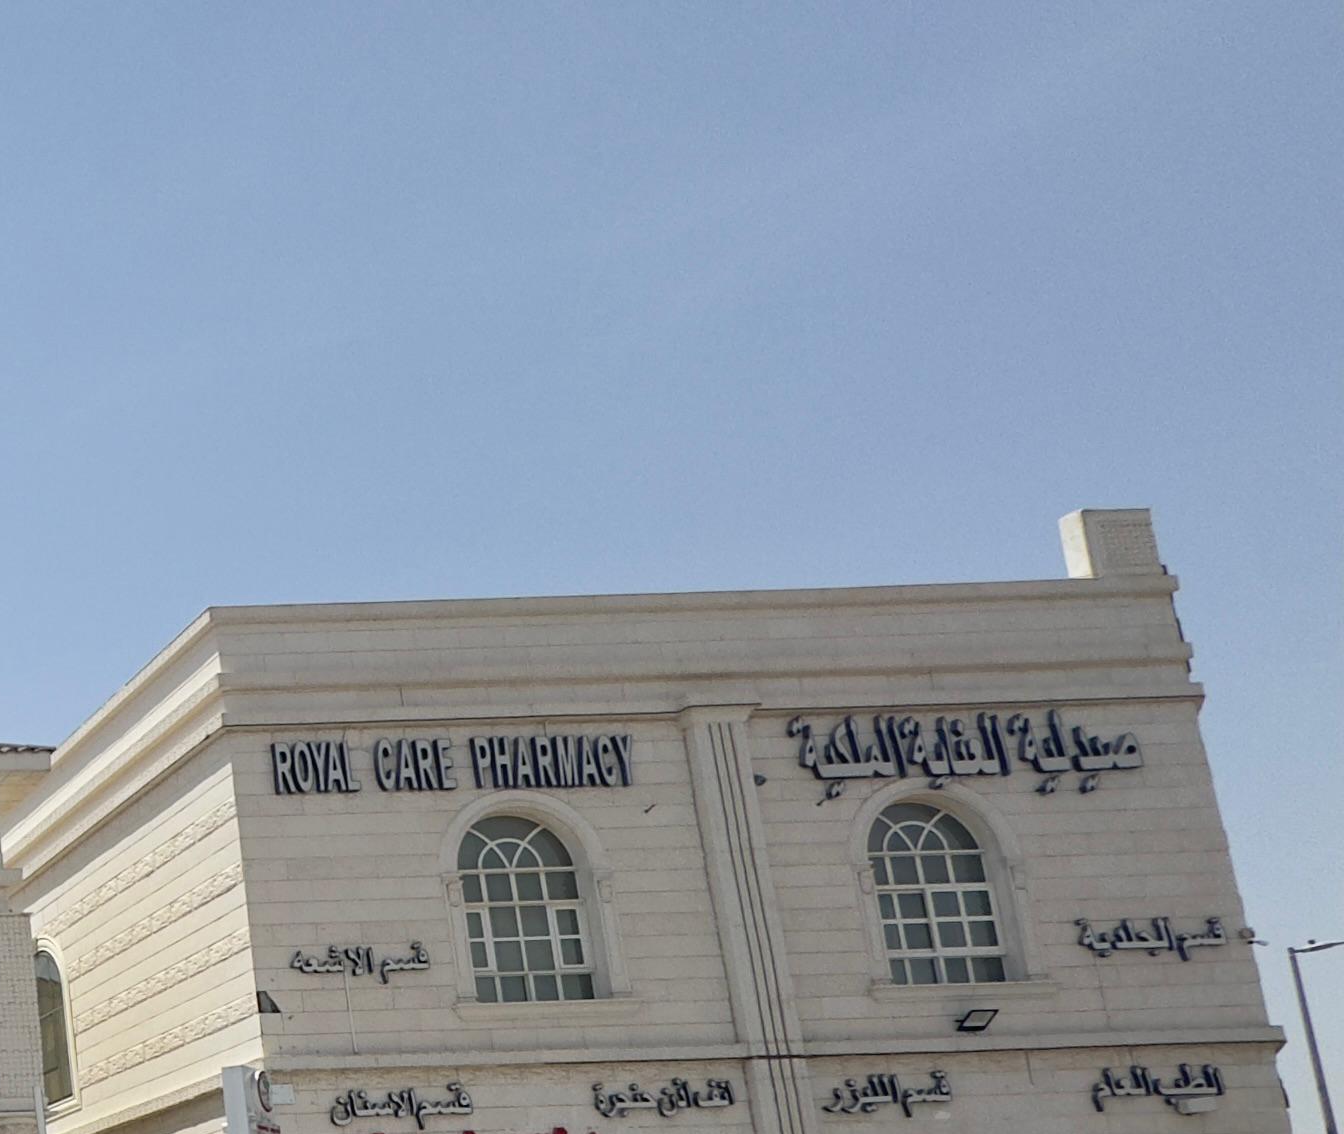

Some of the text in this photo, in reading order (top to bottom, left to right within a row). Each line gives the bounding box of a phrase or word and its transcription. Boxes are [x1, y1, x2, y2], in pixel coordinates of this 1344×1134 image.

[271, 734, 634, 795] ROYAL CARE PHARMACY
[786, 708, 1144, 800] صيدلية العناية الملكية
[379, 941, 431, 984] قسم
[1074, 916, 1227, 962] قسم الجلدية
[415, 1082, 474, 1130] قسم
[592, 1082, 659, 1118] حنجرة
[822, 1070, 952, 1118] قسم الليزر
[1091, 1063, 1226, 1112] الطب العام
